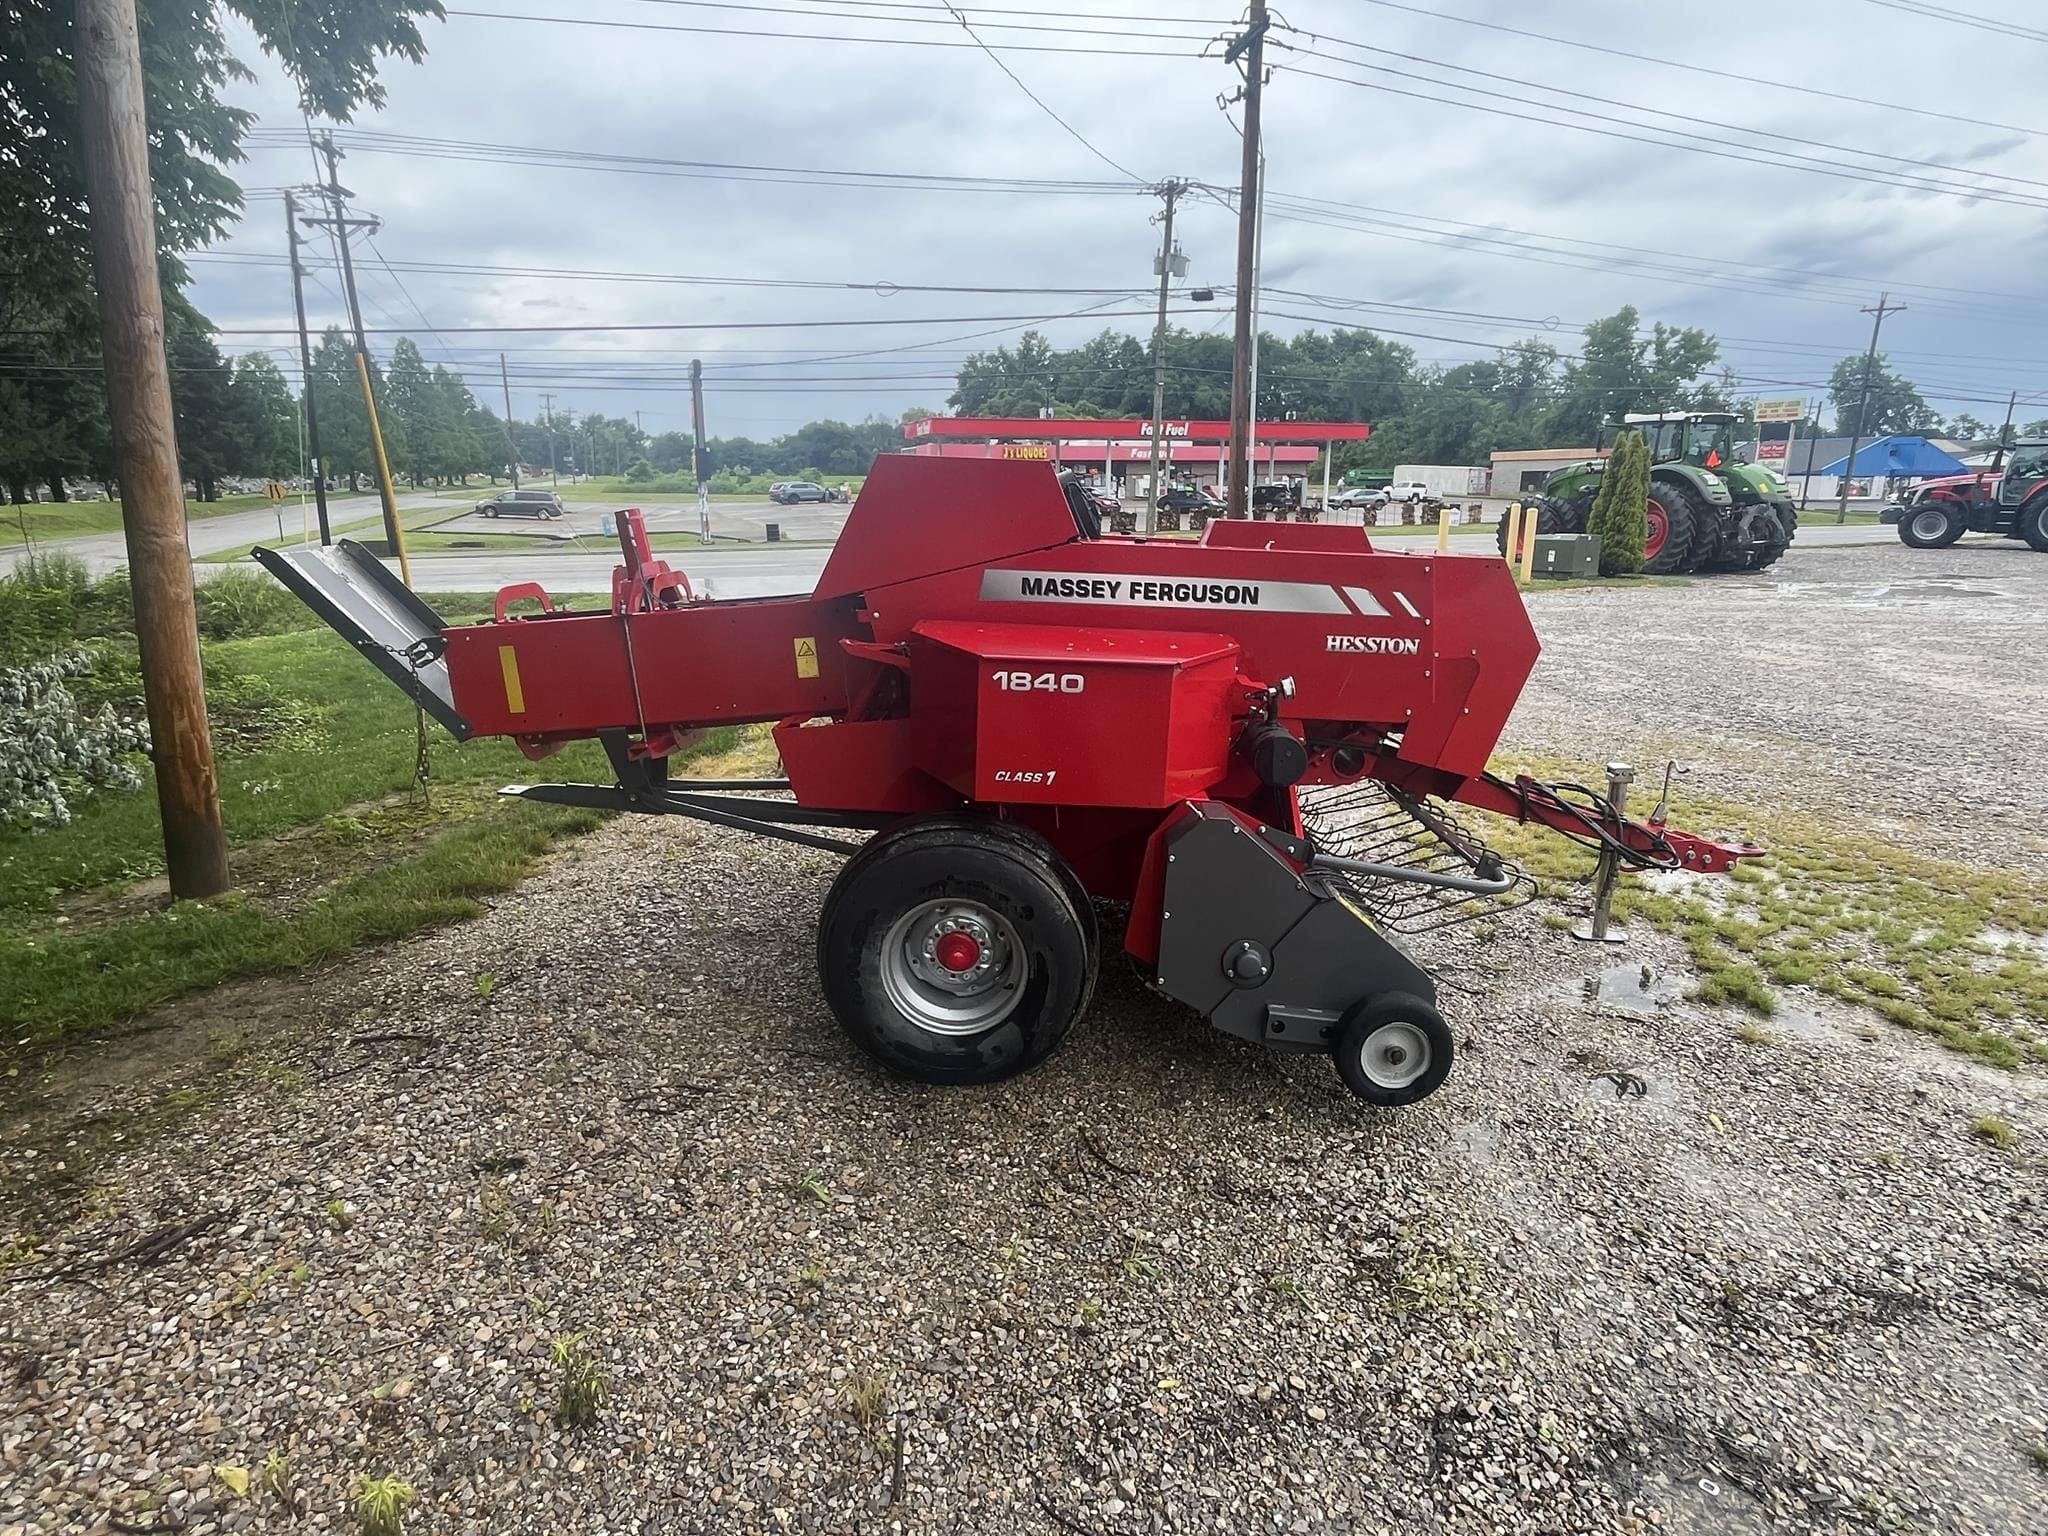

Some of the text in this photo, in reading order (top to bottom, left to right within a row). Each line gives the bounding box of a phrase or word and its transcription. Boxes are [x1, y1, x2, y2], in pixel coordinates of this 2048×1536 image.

[1140, 422, 1190, 436] Fat Fuel
[1016, 447, 1048, 459] LIQUORS
[1021, 577, 1260, 605] MASSEY FERGUSON
[1326, 635, 1421, 656] HESSTON
[992, 671, 1085, 694] 1840
[995, 771, 1057, 786] CLASS 1
